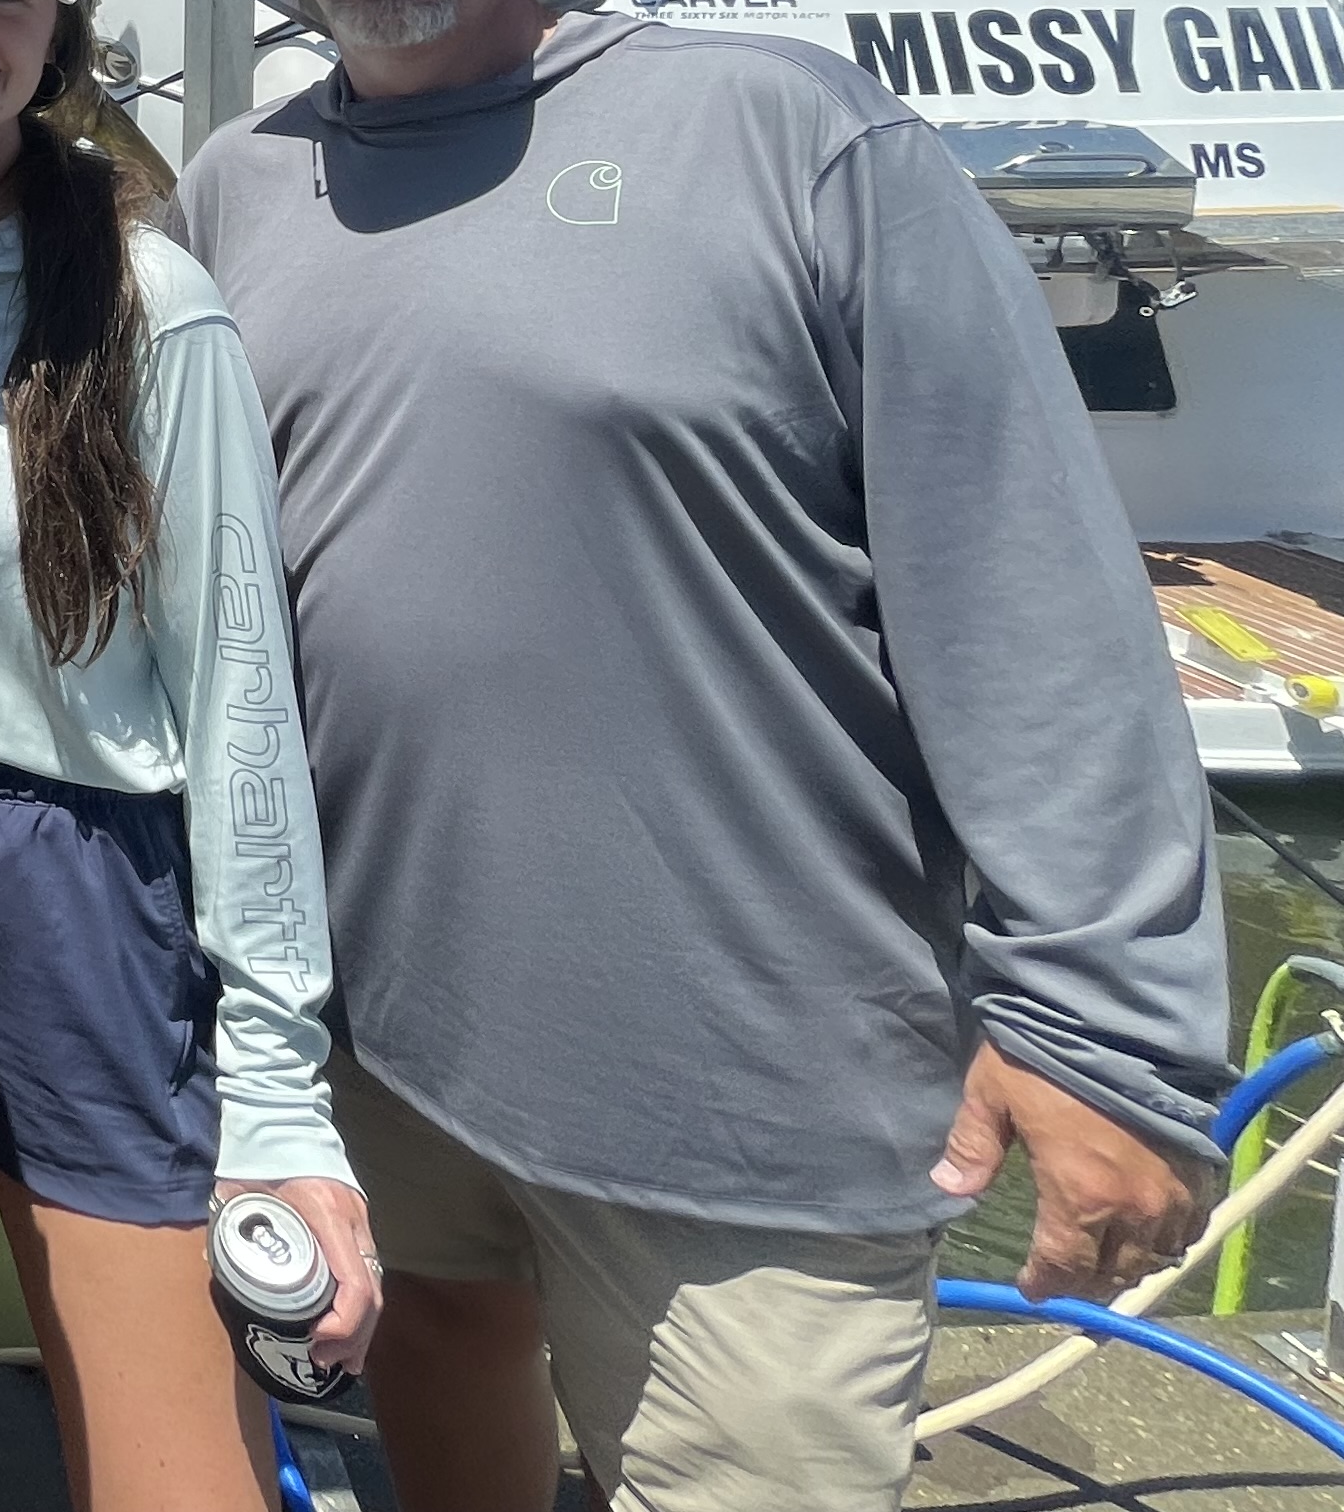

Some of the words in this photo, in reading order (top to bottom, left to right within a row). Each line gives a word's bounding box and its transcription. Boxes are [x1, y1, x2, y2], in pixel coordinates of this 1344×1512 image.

[680, 11, 716, 20] SIXTY
[719, 11, 739, 20] SIX
[845, 7, 1142, 96] MISSY
[1190, 142, 1266, 179] MS
[213, 512, 311, 994] carhartt
